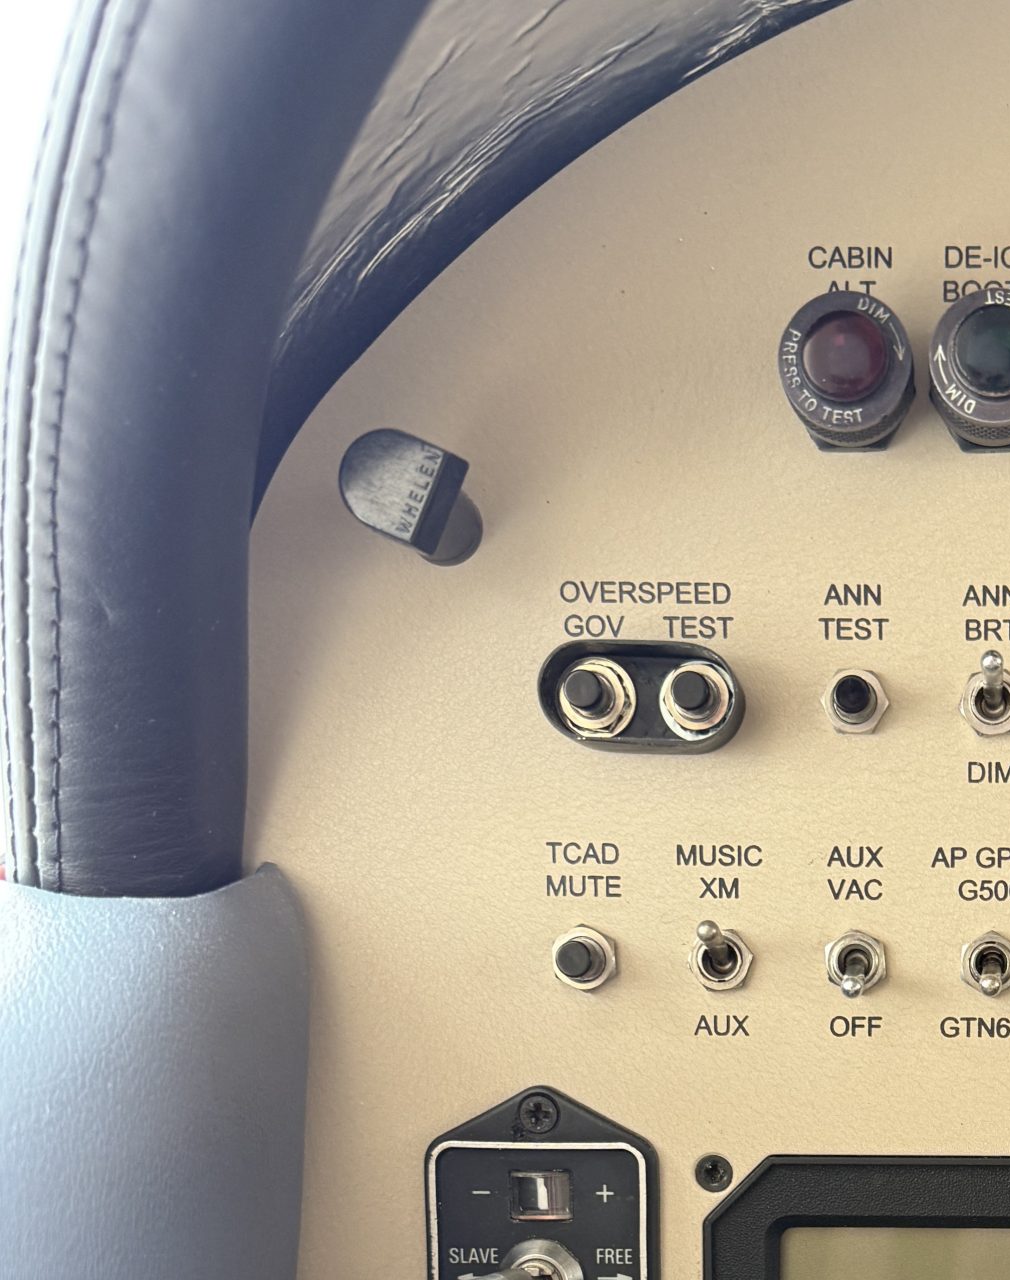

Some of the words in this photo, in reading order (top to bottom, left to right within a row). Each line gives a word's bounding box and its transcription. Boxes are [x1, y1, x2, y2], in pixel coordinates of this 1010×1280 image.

[808, 245, 893, 270] CABIN
[857, 297, 891, 324] DIM
[782, 328, 801, 388] PRESS
[799, 389, 818, 411] TO
[822, 406, 863, 424] TEST
[945, 383, 977, 414] DIM
[395, 450, 442, 534] WHELEN
[559, 580, 732, 605] OVERSPEED
[823, 583, 882, 606] ANN
[564, 613, 625, 638] GOV
[662, 615, 734, 640] TEST
[818, 617, 890, 641] TEST
[545, 841, 620, 865] TCAD
[676, 844, 763, 867] MUSIC
[826, 845, 884, 868] AUX
[930, 846, 968, 869] AP
[546, 874, 622, 898] MUTE
[699, 877, 740, 899] XM
[827, 878, 883, 901] VAC
[694, 1014, 750, 1037] AUX
[829, 1015, 883, 1038] OFF
[449, 1247, 499, 1264] SLAVE
[596, 1248, 633, 1265] FREE
